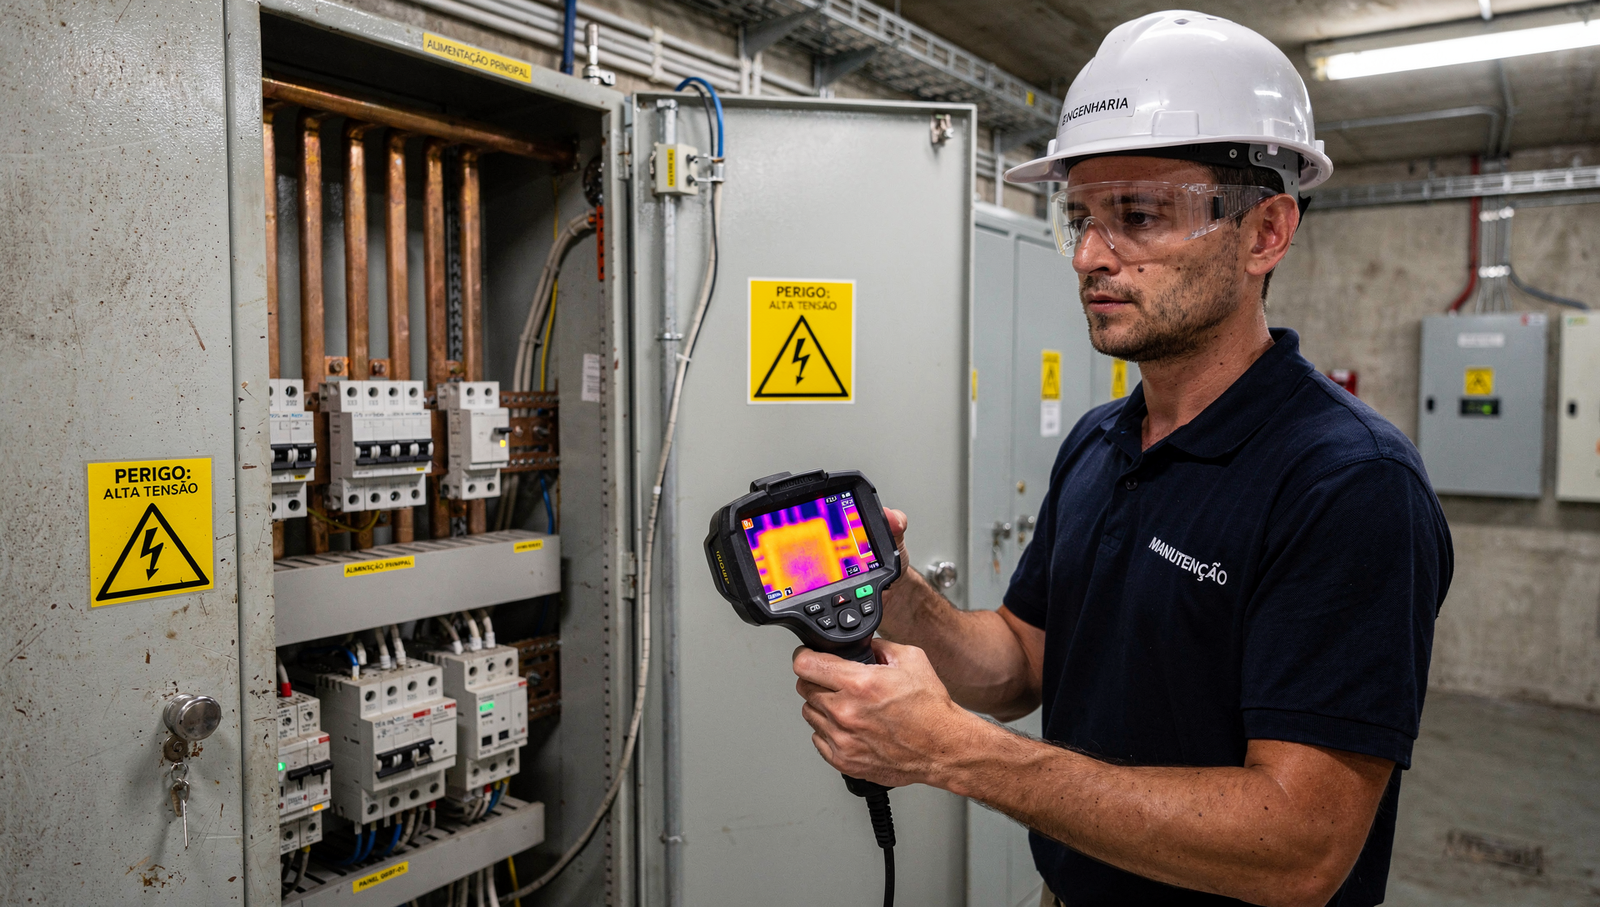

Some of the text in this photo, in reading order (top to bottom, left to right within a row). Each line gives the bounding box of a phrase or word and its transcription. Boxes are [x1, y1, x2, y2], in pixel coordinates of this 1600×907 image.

[427, 39, 489, 65] ALIMENTAÇÃO
[1061, 97, 1129, 126] ENGENHARIA
[776, 285, 831, 299] PERIGO:
[769, 300, 794, 310] ALTA
[115, 465, 191, 484] PERIGO:
[103, 480, 198, 500] ALTA TENSÃO
[1148, 536, 1228, 586] MANUTENÇÃO
